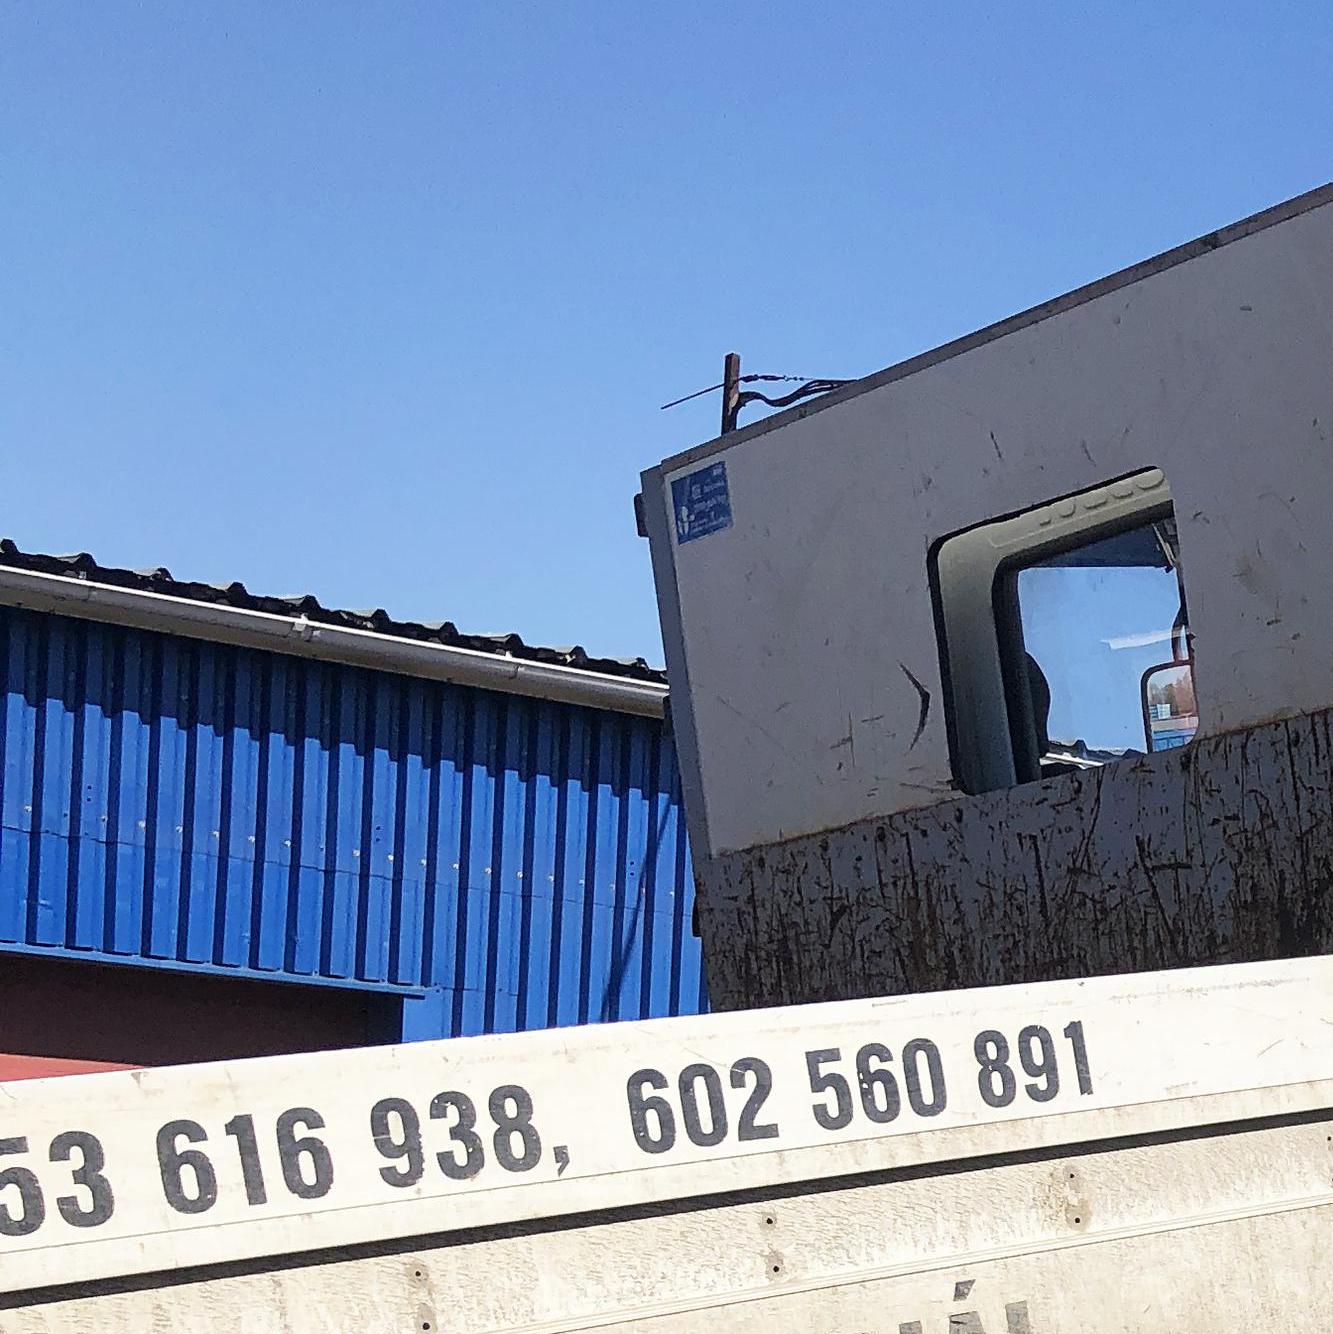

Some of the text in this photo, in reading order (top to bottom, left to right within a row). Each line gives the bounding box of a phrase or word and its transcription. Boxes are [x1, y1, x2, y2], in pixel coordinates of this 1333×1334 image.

[0, 1020, 1093, 1237] 53 616 938, 602 560 891
